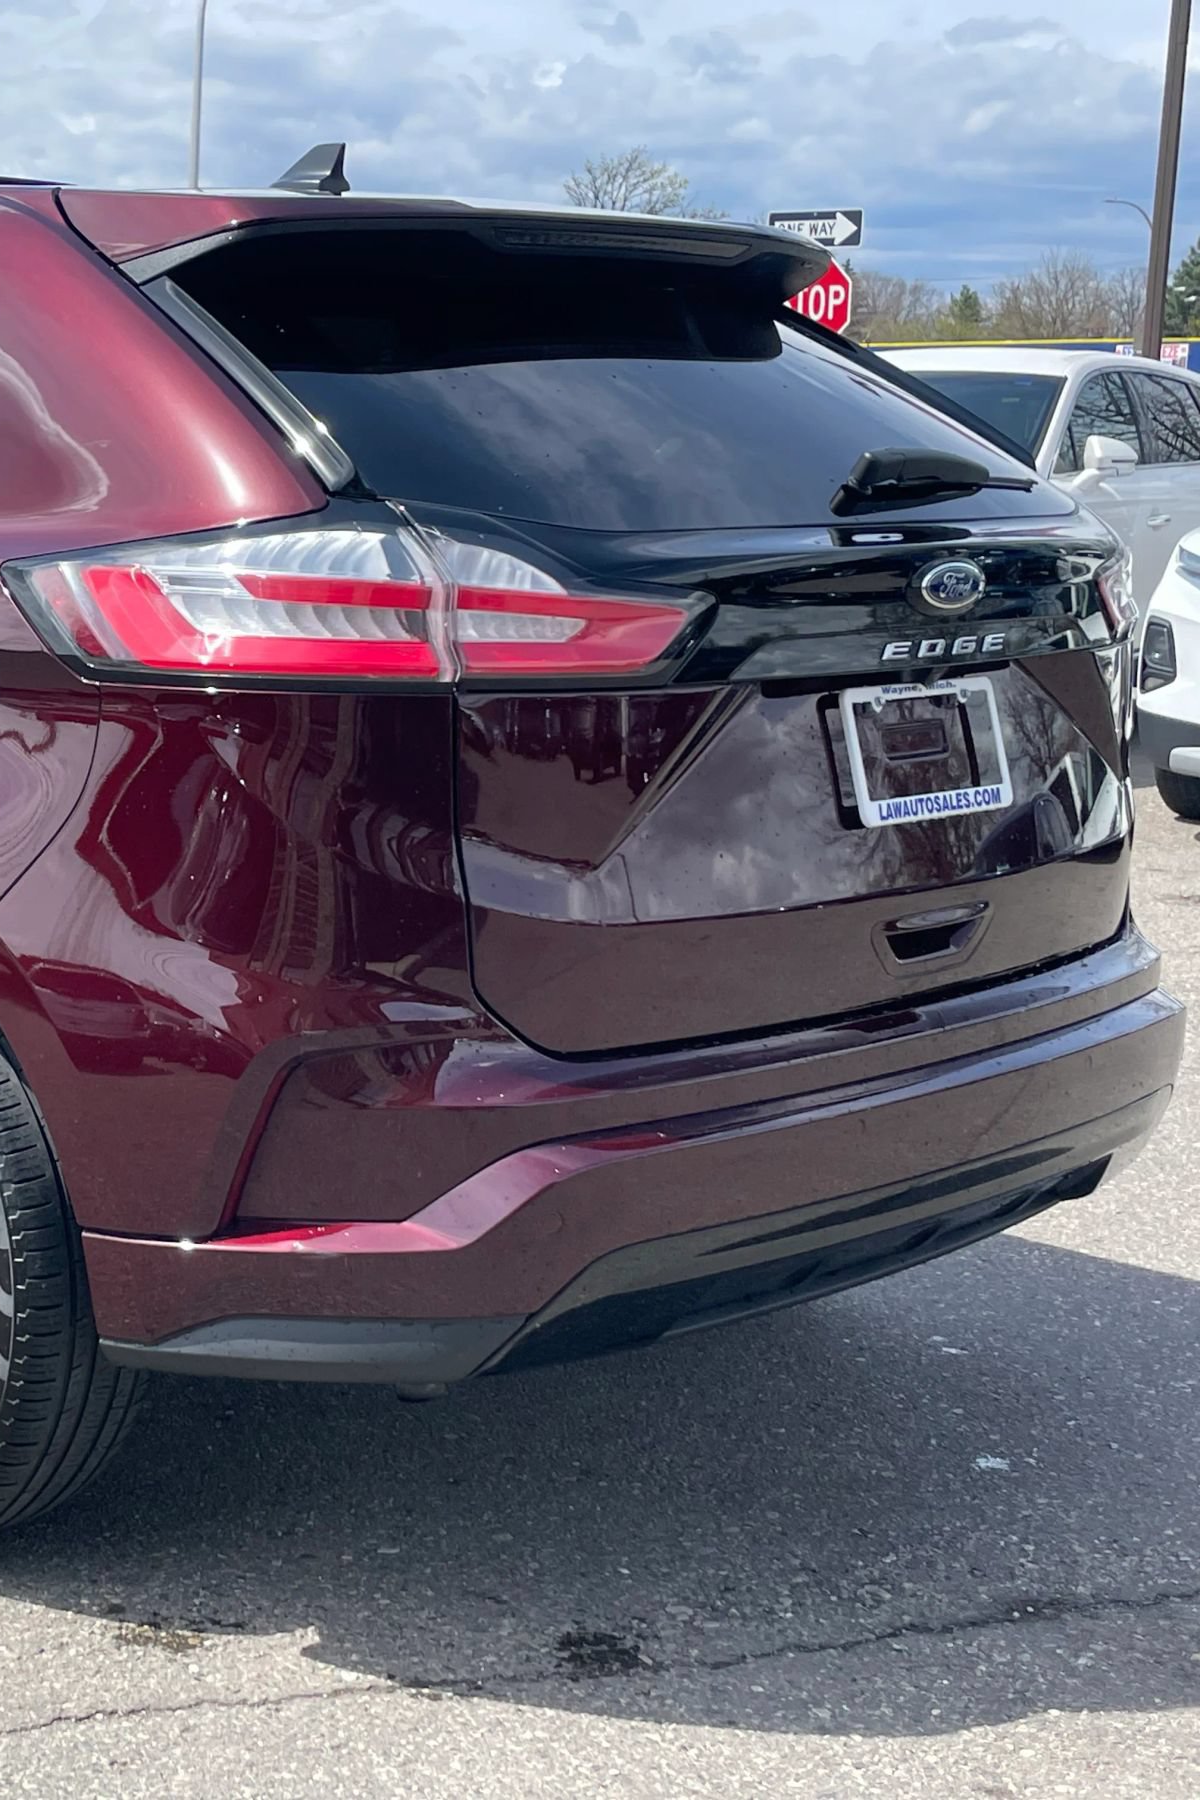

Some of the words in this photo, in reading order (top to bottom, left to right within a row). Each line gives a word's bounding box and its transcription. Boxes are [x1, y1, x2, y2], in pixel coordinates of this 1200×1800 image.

[808, 221, 836, 237] WAY
[786, 284, 846, 322] TOP
[939, 572, 974, 599] Ford
[881, 632, 1006, 661] EDGE
[880, 683, 923, 695] Wayne,
[878, 787, 1001, 821] LAWAUTOSALES.COM
